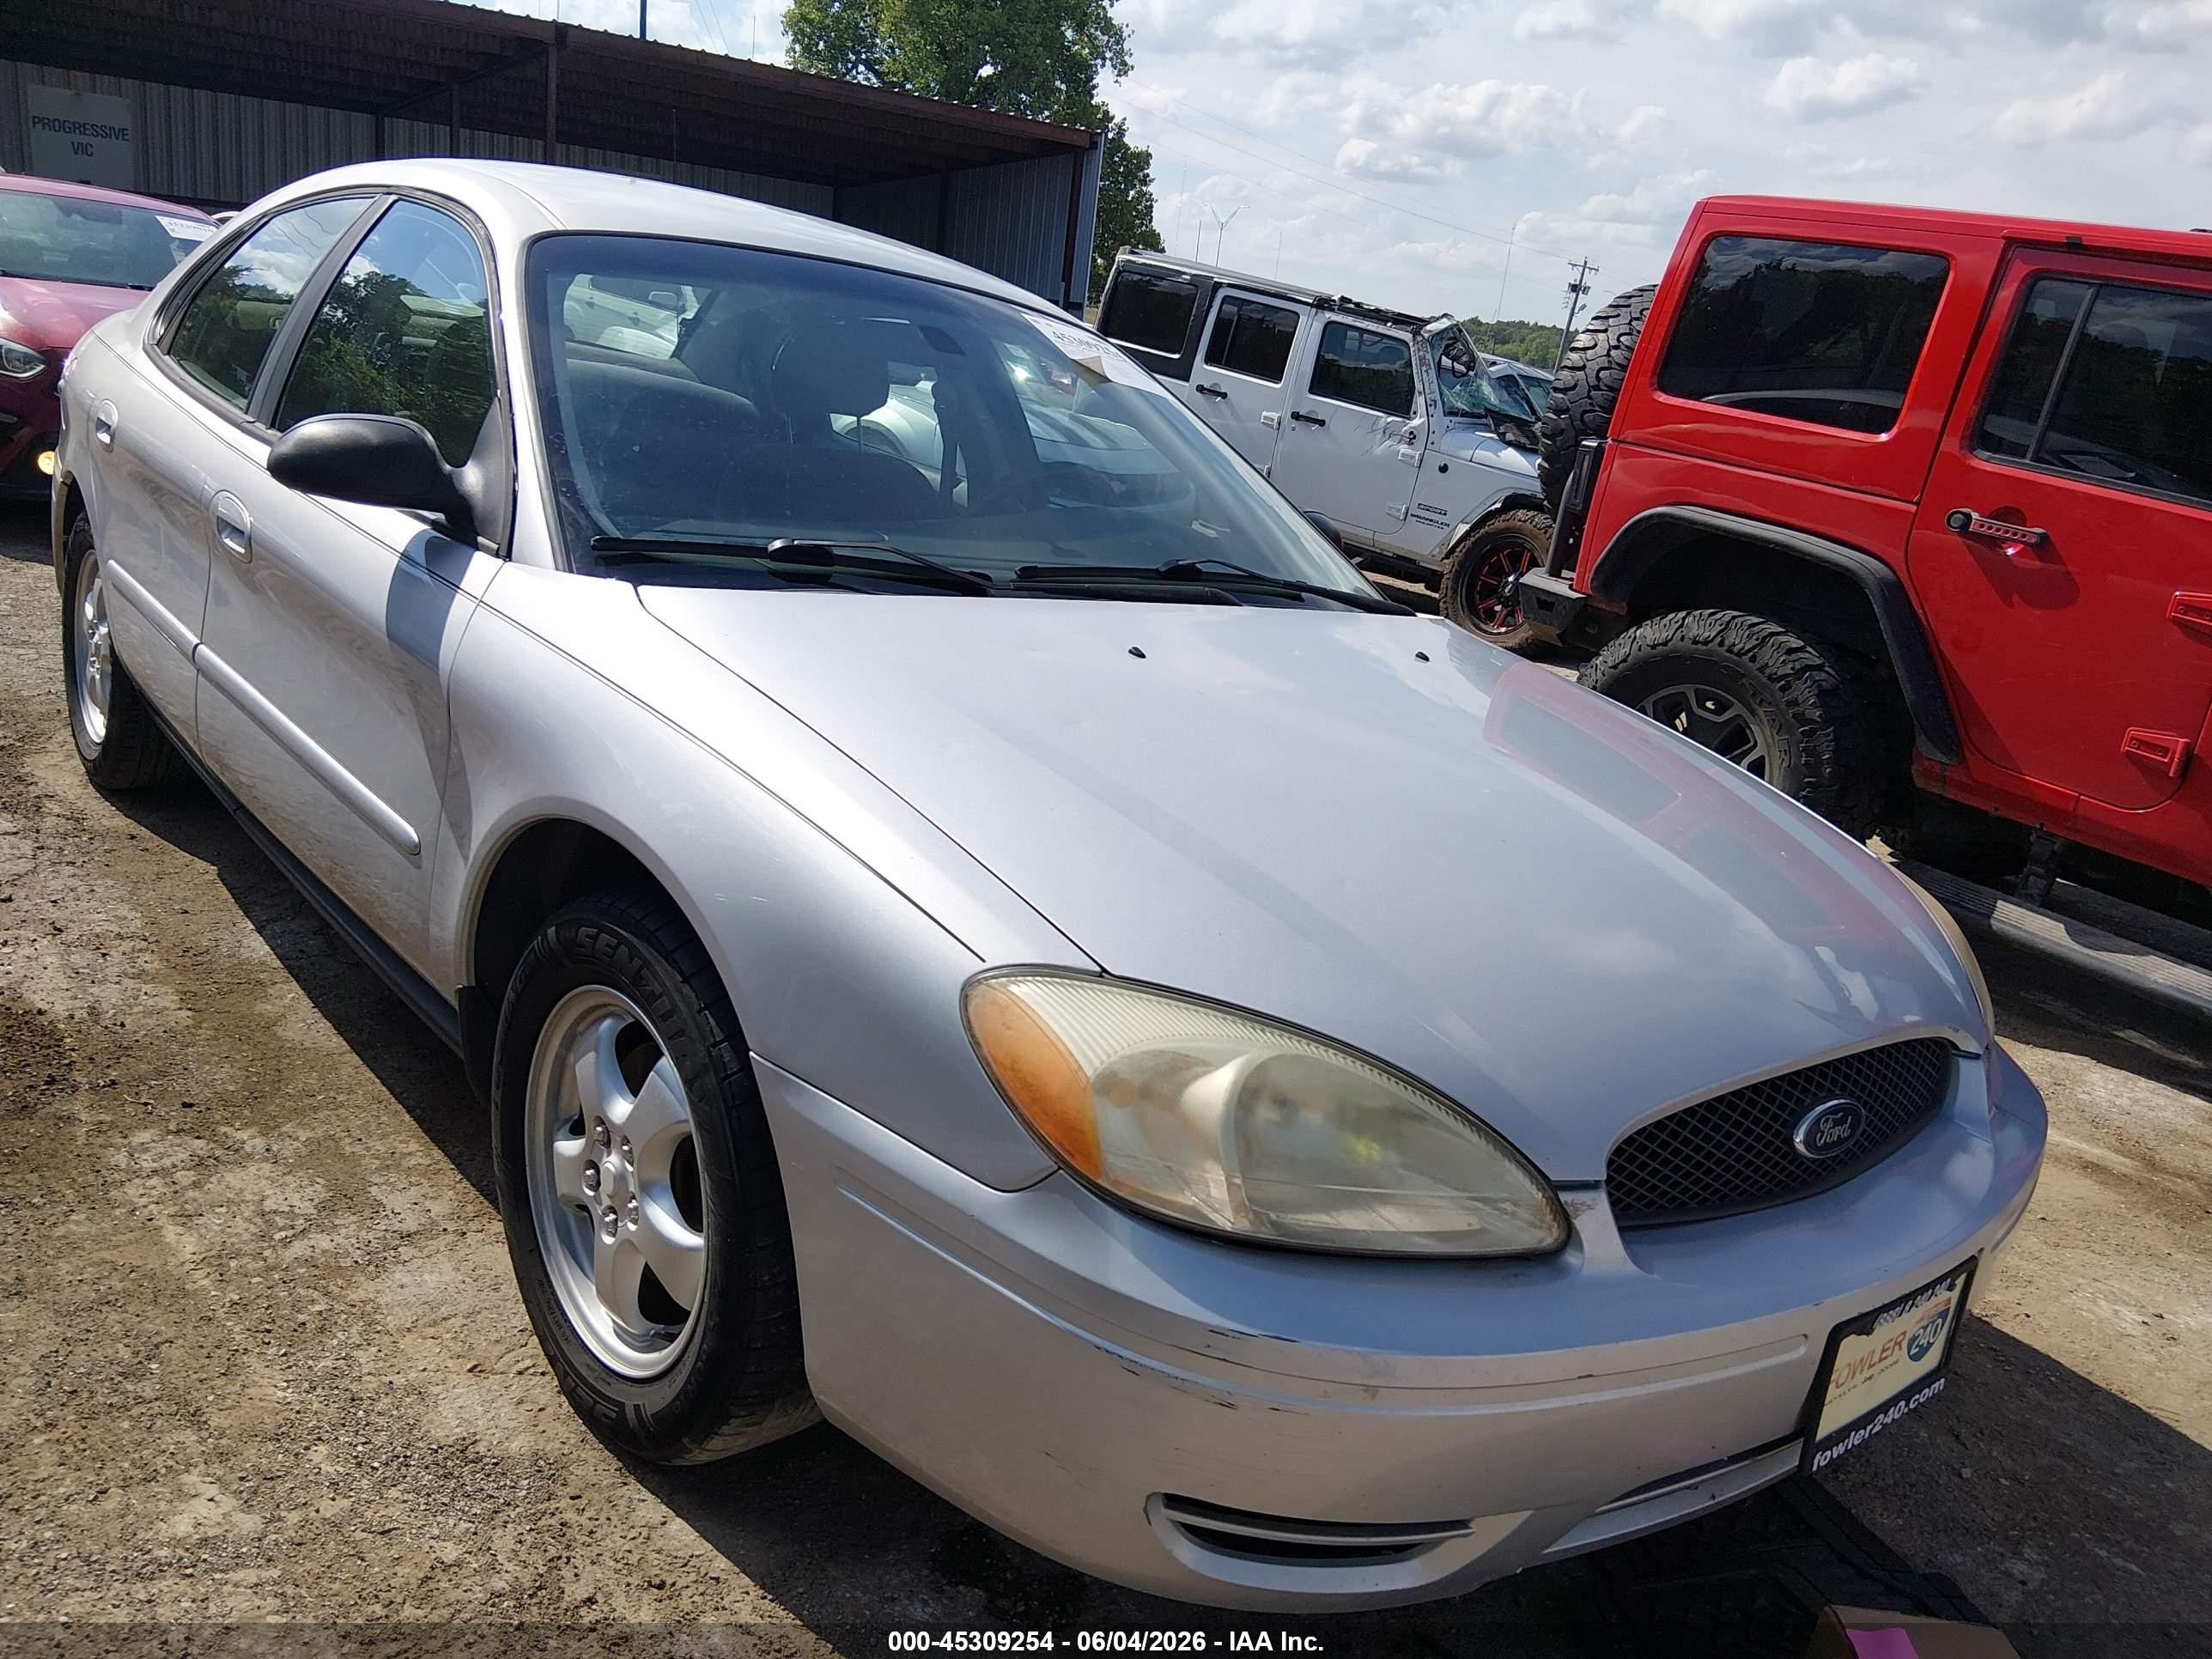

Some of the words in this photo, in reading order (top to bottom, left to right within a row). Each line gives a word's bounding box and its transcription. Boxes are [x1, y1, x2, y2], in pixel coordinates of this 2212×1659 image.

[32, 115, 130, 141] PROGRESSIVE
[70, 141, 94, 157] VIC
[1410, 513, 1450, 528] WRANGLER
[1418, 504, 1447, 516] SPORT
[1816, 1112, 1851, 1146] Ford
[1829, 1330, 1907, 1389] FOWLER
[1910, 1318, 1942, 1356] 240
[1812, 1377, 1945, 1472] fowler240.com
